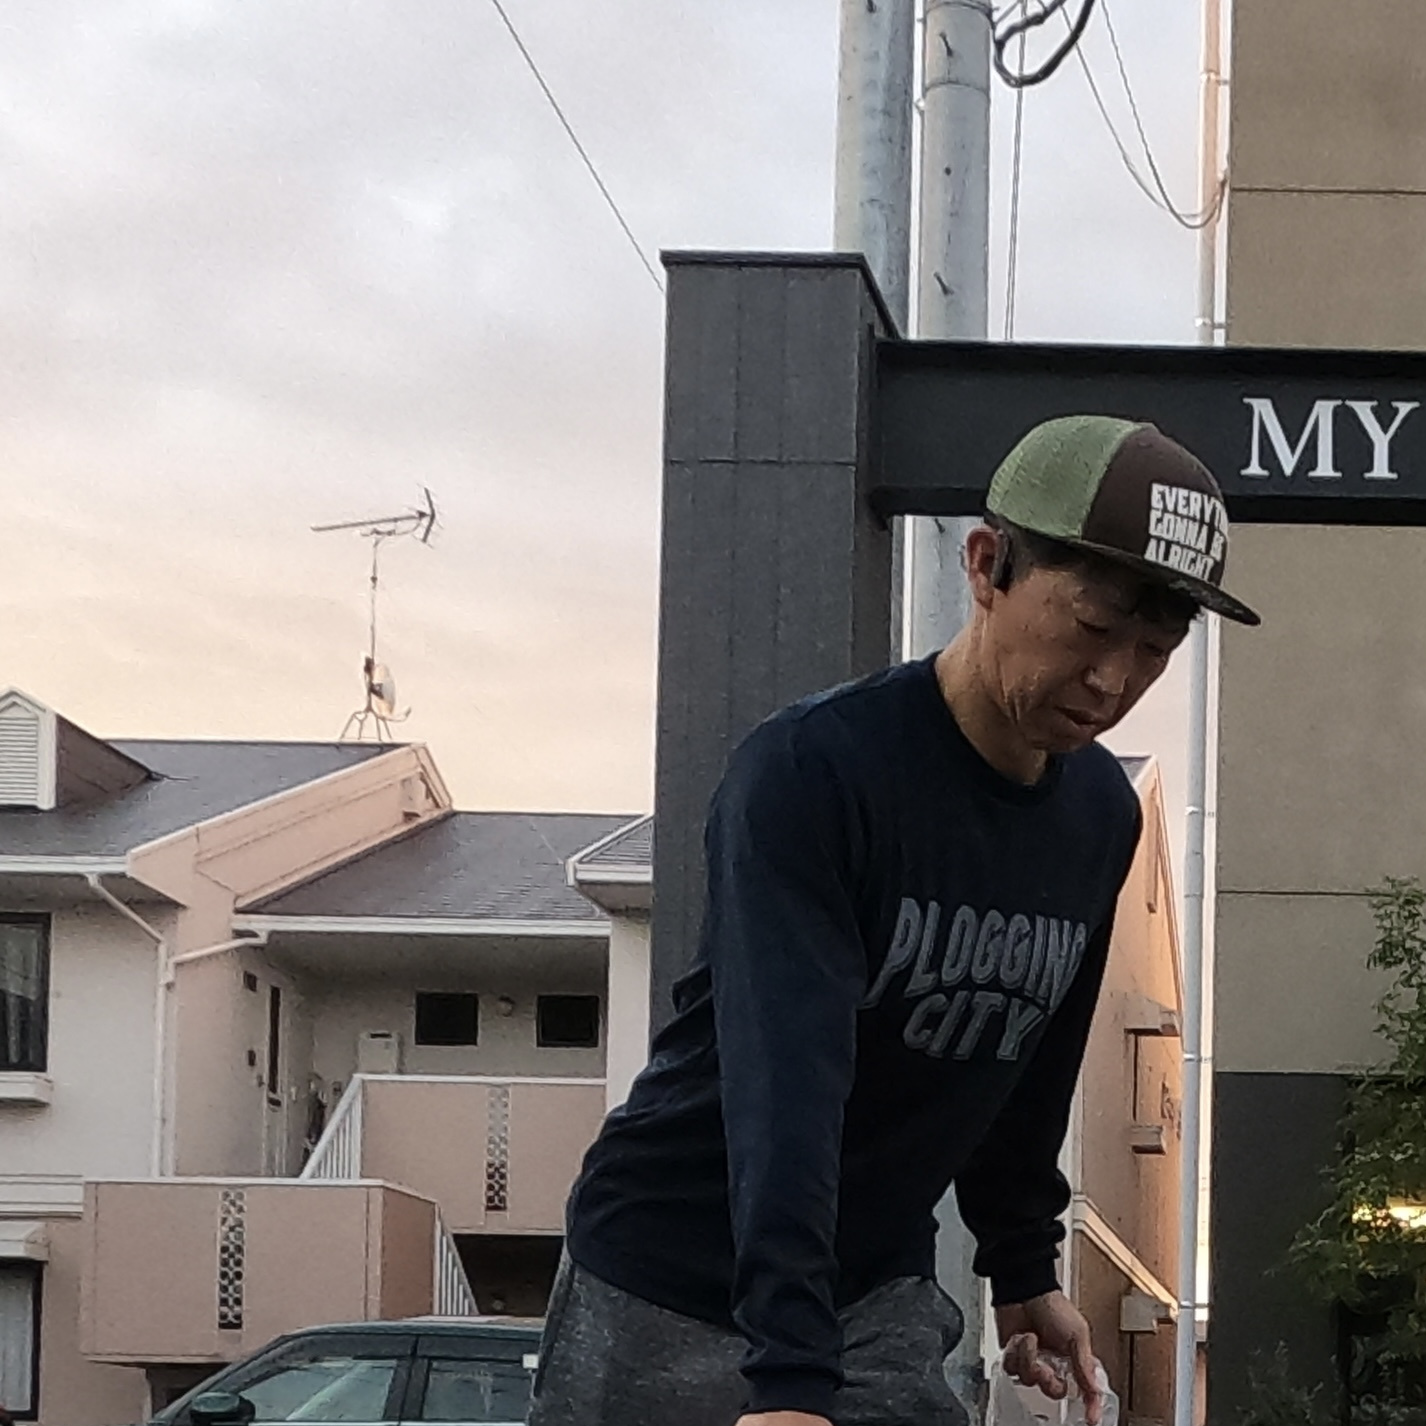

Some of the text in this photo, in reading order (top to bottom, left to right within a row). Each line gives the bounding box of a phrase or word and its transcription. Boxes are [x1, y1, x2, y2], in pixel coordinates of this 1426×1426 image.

[1240, 397, 1420, 480] MY
[1143, 537, 1215, 583] ALRIGHT
[1148, 508, 1209, 555] GONNA
[902, 990, 1046, 1061] CITY
